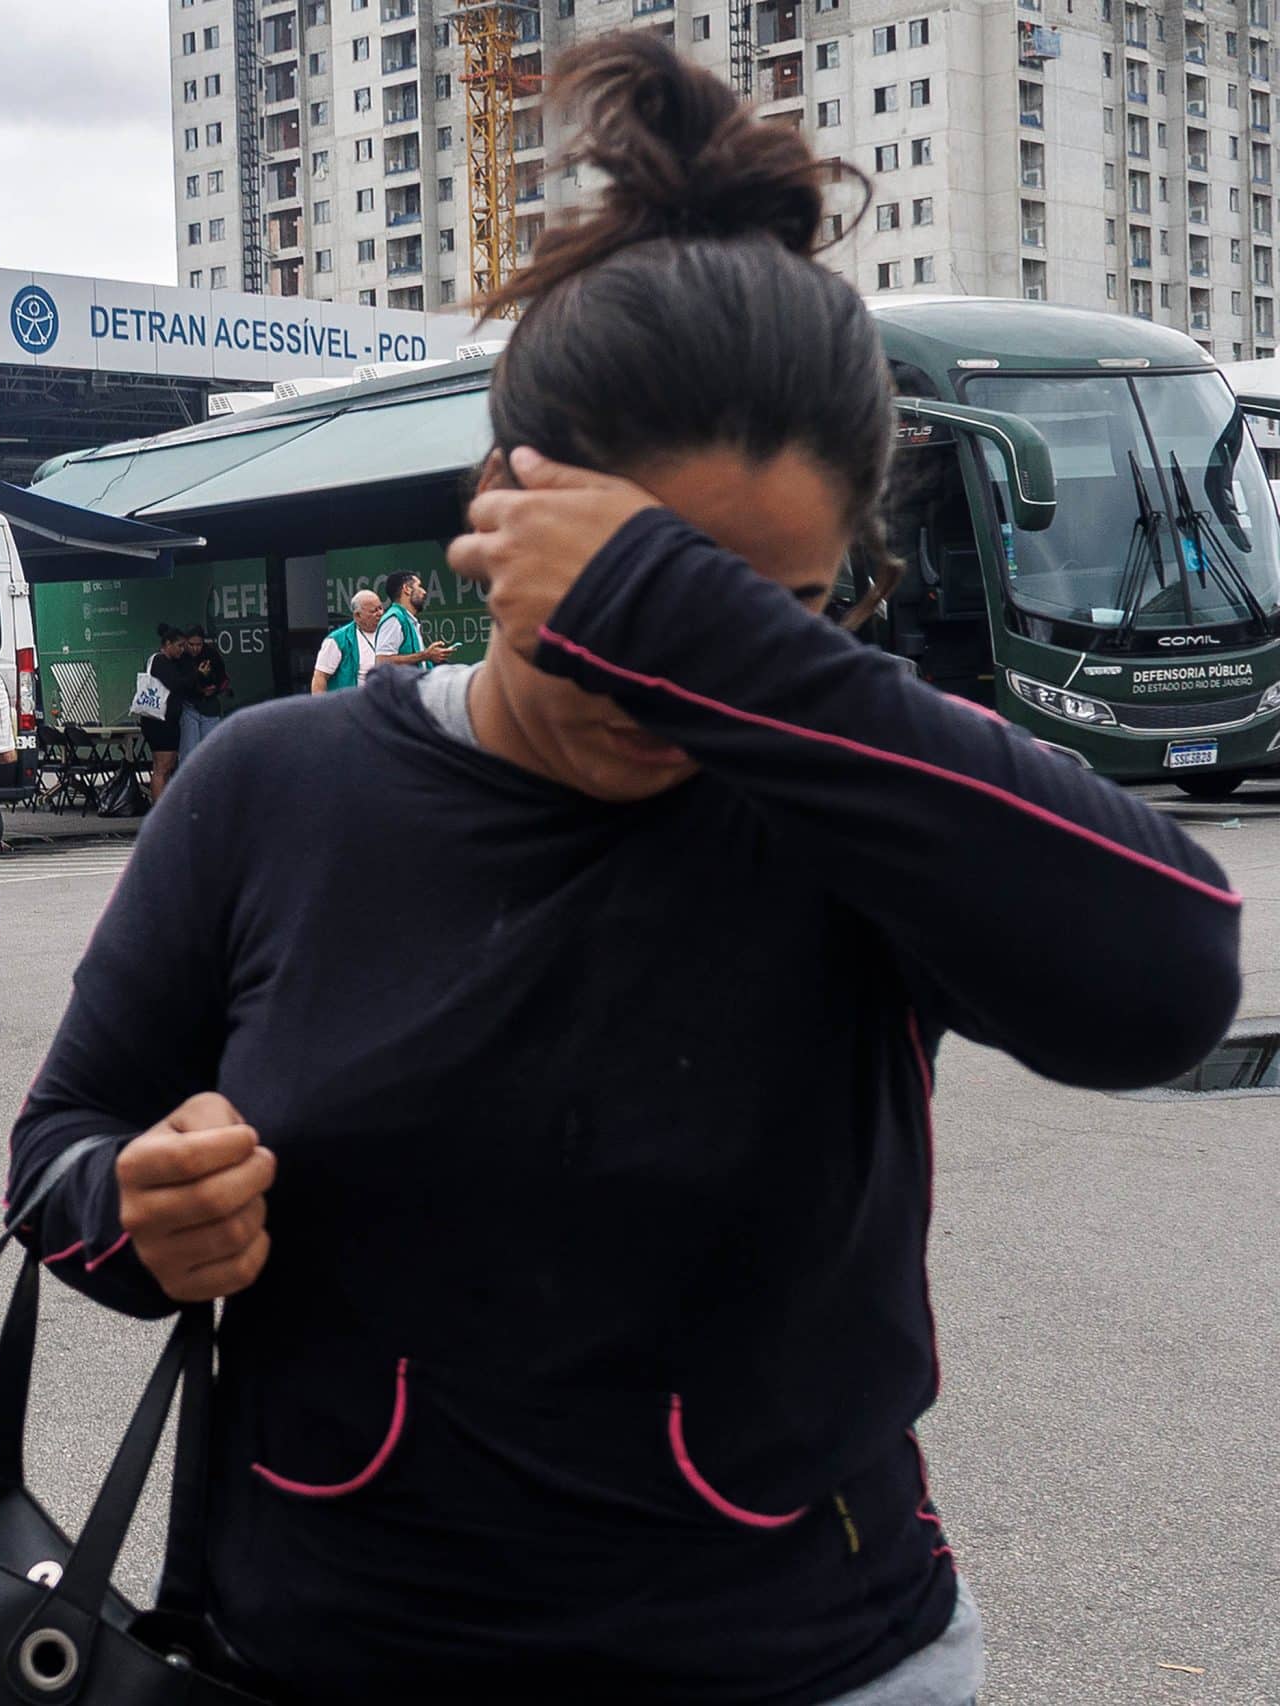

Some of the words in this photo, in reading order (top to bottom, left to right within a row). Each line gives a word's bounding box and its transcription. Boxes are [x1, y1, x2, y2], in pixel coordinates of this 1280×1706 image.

[91, 305, 206, 347] DETRAN
[215, 317, 358, 360] ACESSÍVEL
[379, 333, 426, 362] PCD
[1158, 635, 1221, 646] COMIL
[1133, 666, 1206, 683] DEFENSORIA
[1209, 663, 1253, 679] PÚBLICA
[1133, 684, 1146, 694] DO
[1148, 681, 1180, 693] ESTADO
[1181, 681, 1194, 691] DO
[1195, 680, 1209, 689] RIO
[1210, 679, 1221, 689] DE
[1222, 677, 1253, 688] JANEIRO
